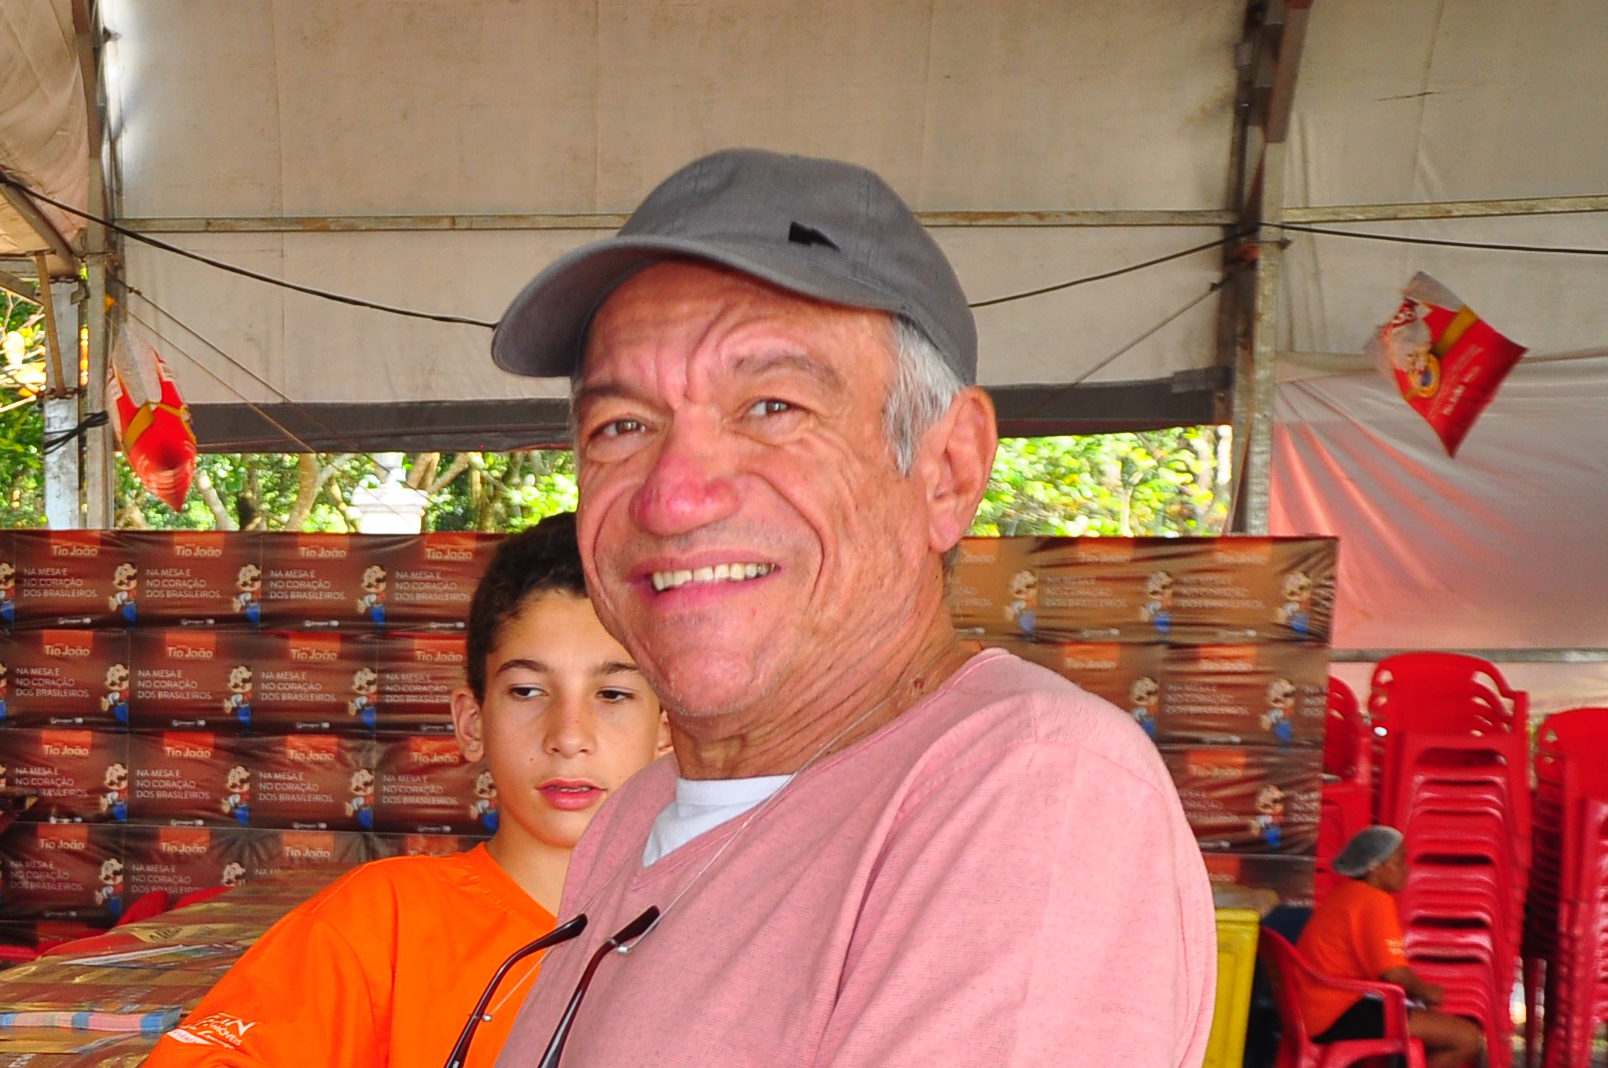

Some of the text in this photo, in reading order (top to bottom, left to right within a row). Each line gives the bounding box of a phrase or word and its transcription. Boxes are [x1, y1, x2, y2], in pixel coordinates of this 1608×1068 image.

[175, 545, 222, 557] Tio João
[146, 568, 159, 577] NA
[160, 568, 183, 577] MESA
[146, 577, 207, 590] NO CORAÇÃO
[146, 589, 165, 599] DOS
